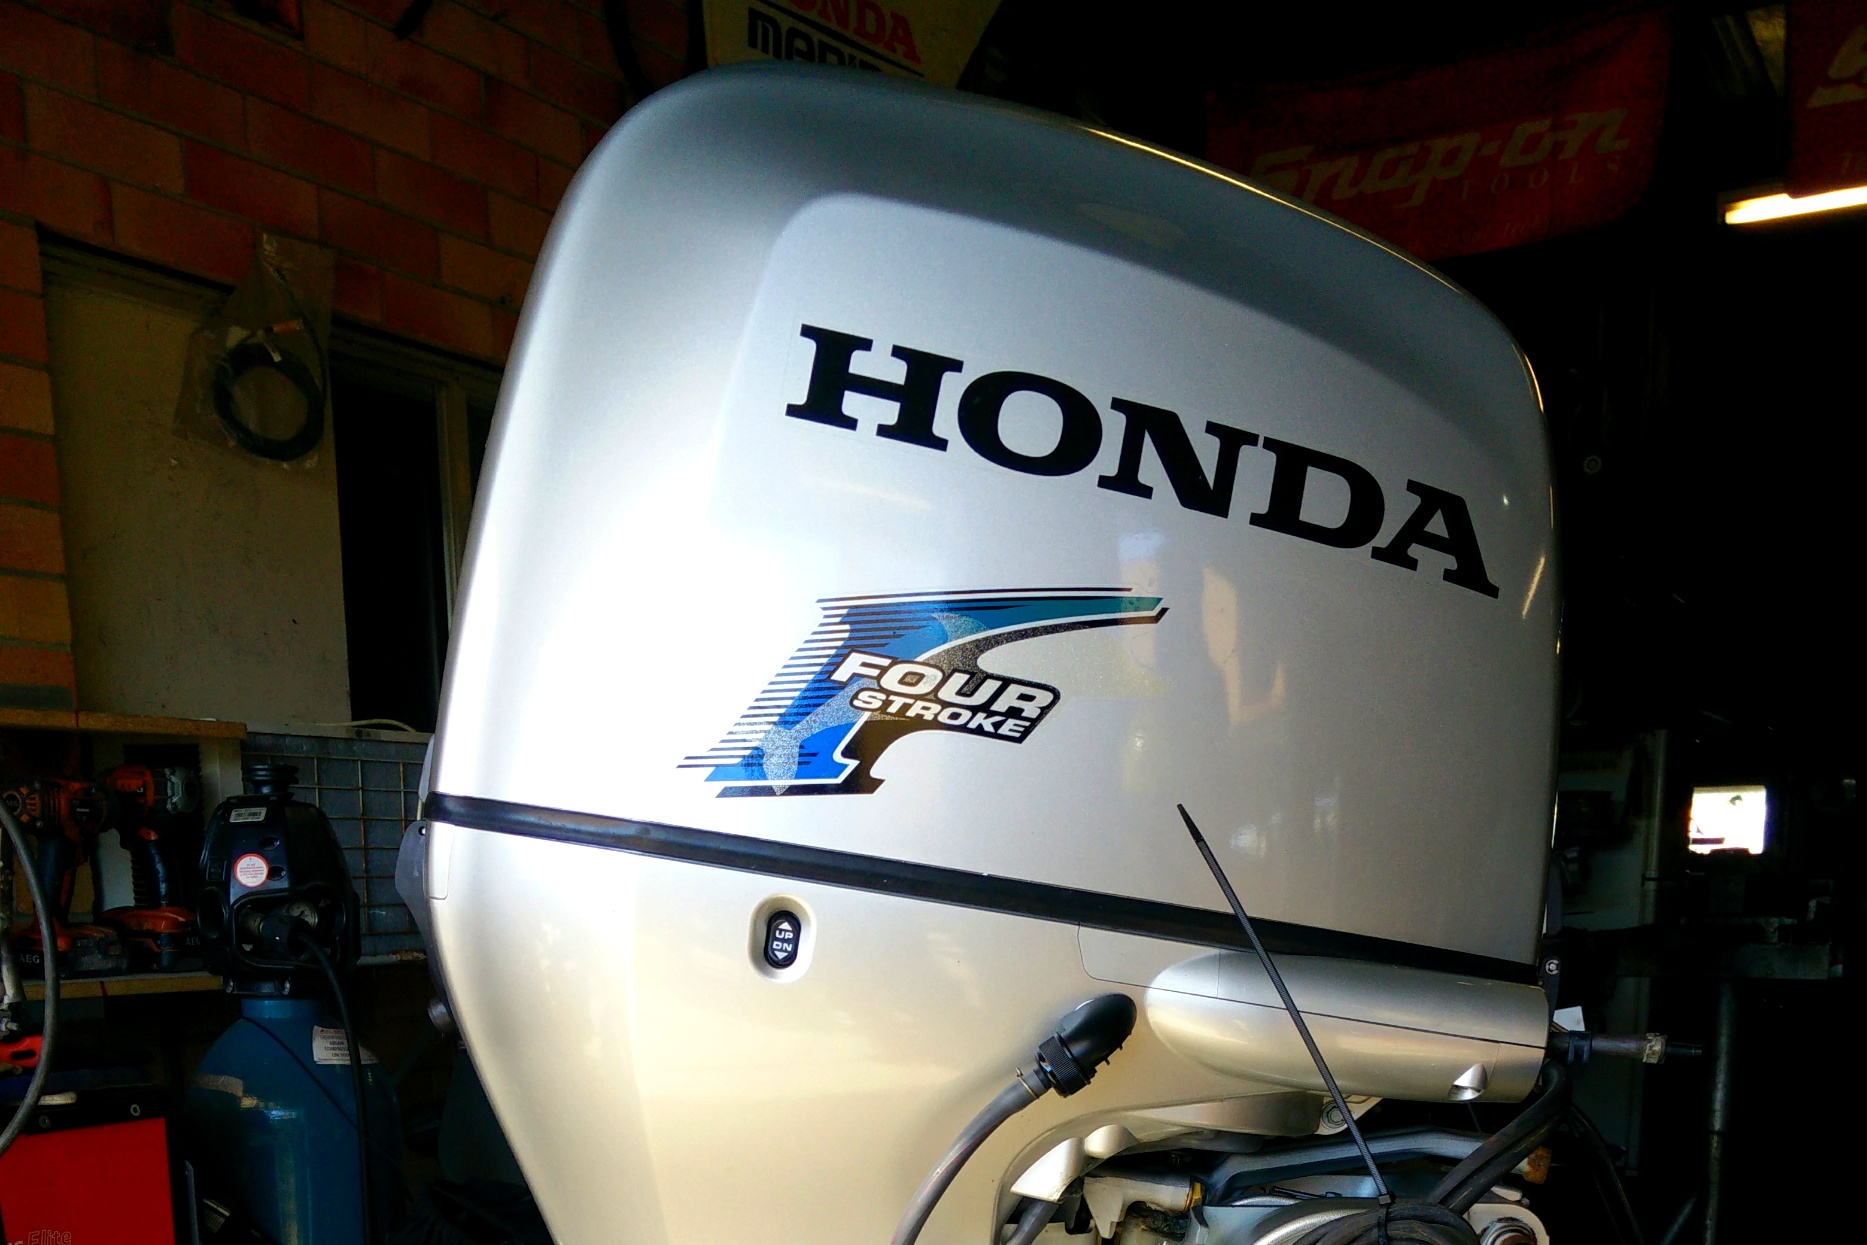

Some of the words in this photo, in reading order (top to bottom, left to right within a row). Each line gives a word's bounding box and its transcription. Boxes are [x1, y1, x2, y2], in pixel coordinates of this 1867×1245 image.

[790, 0, 921, 64] NDA
[1251, 106, 1629, 209] Snap-on
[1460, 155, 1622, 201] TOOLS
[785, 323, 1500, 600] HONDA
[830, 652, 1054, 719] FOUR
[852, 690, 1031, 738] STROKE
[18, 953, 41, 964] AEG
[772, 941, 793, 952] DN
[775, 929, 793, 940] UP
